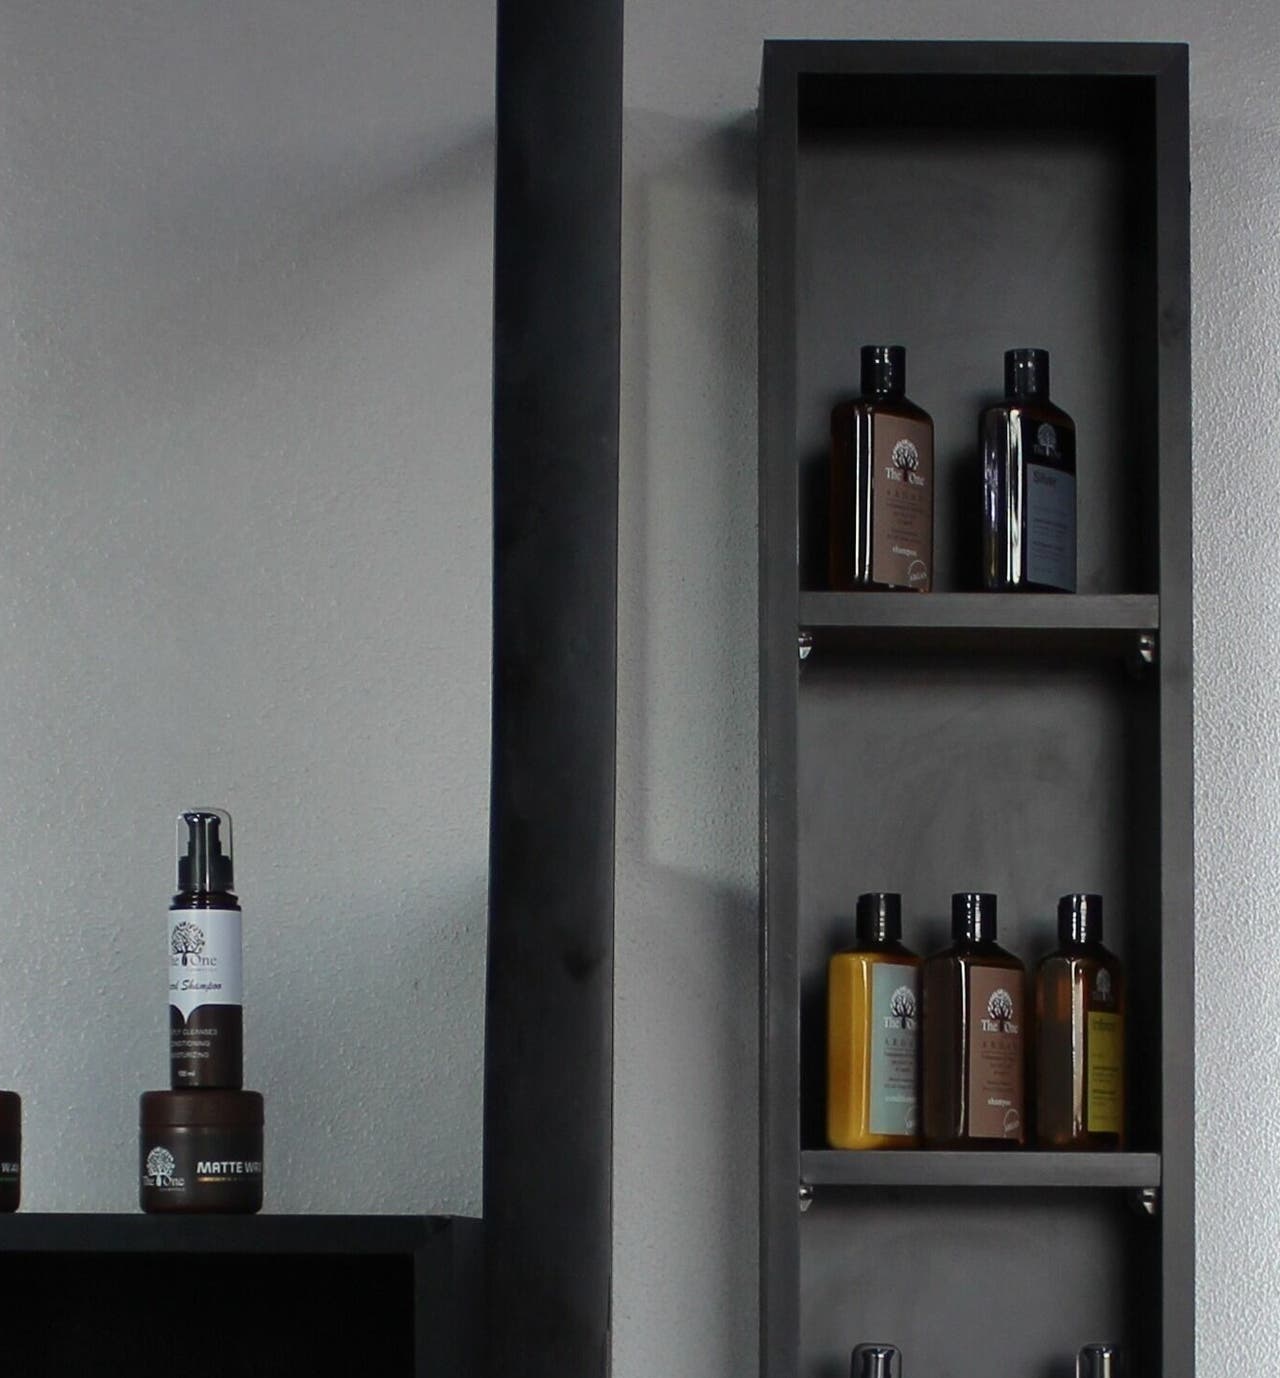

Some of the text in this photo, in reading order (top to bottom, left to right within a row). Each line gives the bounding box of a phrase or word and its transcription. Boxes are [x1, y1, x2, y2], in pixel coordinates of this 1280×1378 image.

[885, 466, 901, 481] The
[190, 954, 217, 967] One
[181, 979, 222, 993] Shampoo
[884, 1016, 899, 1029] The
[981, 1019, 998, 1032] The
[1, 1163, 18, 1173] WA
[197, 1161, 243, 1173] MATTE
